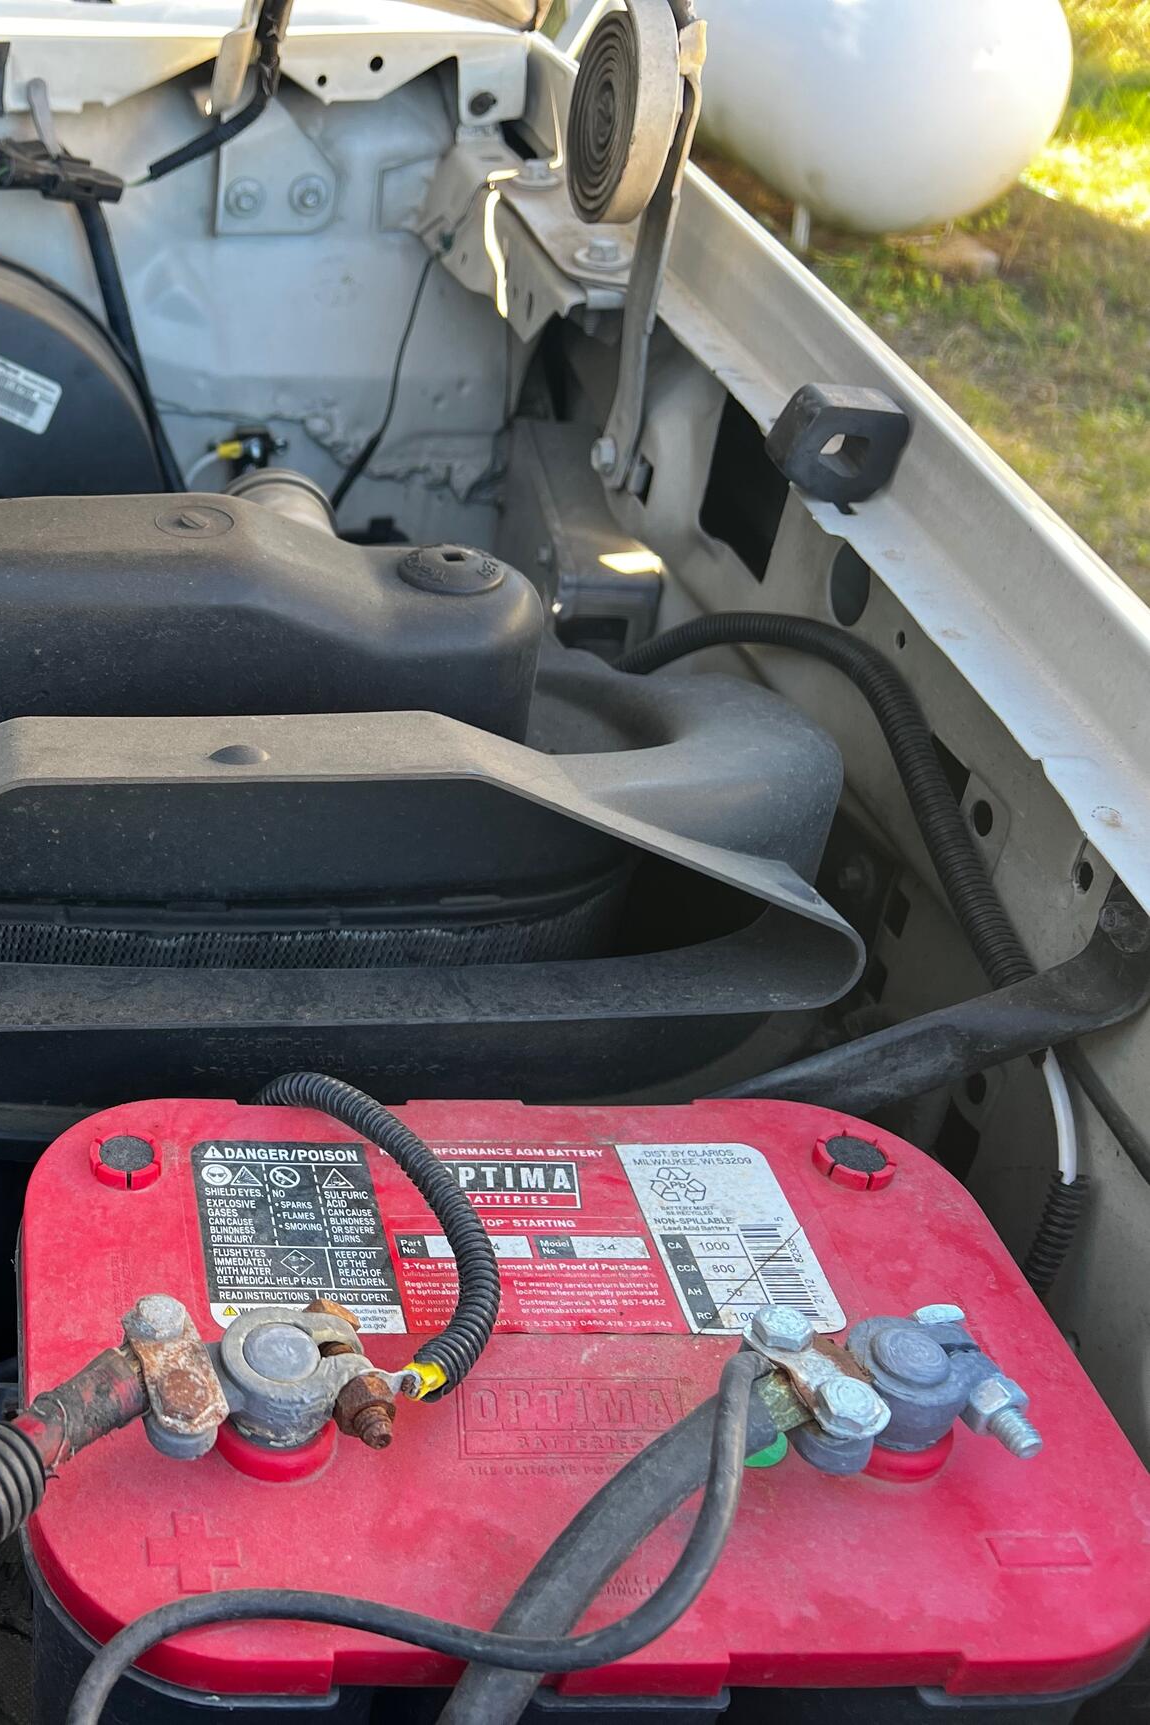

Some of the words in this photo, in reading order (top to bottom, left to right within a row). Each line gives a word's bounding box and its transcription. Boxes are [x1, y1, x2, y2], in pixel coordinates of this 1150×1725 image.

[224, 1147, 358, 1162] DANGER/POISON
[433, 1148, 513, 1156] RFORMANCE
[516, 1148, 544, 1156] AGM
[547, 1148, 603, 1158] BATTERY
[671, 1150, 685, 1158] BY
[687, 1149, 734, 1157] CLARIOS
[633, 1158, 700, 1166] MILWAUKEE,
[703, 1157, 716, 1165] WI
[717, 1157, 752, 1165] 53209
[446, 1166, 572, 1190] PTIMA
[670, 1181, 686, 1189] Pb
[204, 1187, 237, 1197] SHIELD
[238, 1188, 264, 1197] EYES.
[272, 1189, 286, 1198] NO
[324, 1191, 369, 1200] SULFURIC
[206, 1199, 257, 1209] EXPLOSIVE
[326, 1199, 348, 1208] ACID
[466, 1195, 549, 1205] ATTERIES
[280, 1201, 313, 1209] SPARKS
[207, 1208, 238, 1217] GASES
[282, 1212, 316, 1220] FLAMES
[327, 1208, 345, 1216] CAN
[345, 1209, 373, 1217] CAUSE
[209, 1217, 225, 1226] CAN
[226, 1218, 254, 1226] CAUSE
[329, 1217, 376, 1226] BLINDNESS
[512, 1219, 577, 1228] STARTING
[653, 1217, 734, 1225] NON-SPILLABLE
[210, 1226, 256, 1234] BLINDNESS
[284, 1222, 323, 1231] SMOKING
[331, 1226, 344, 1234] OR
[344, 1226, 376, 1235] SEVERE
[211, 1235, 223, 1243] OR
[224, 1235, 256, 1243] INJURY.
[400, 1239, 421, 1247] Part
[540, 1239, 570, 1247] Model
[667, 1242, 683, 1250] CA
[699, 1241, 731, 1251] 1000
[213, 1248, 243, 1257] FLUSH
[243, 1249, 266, 1257] EYES
[335, 1251, 358, 1259] KEEP
[359, 1251, 377, 1259] OUT
[542, 1247, 559, 1255] No.
[214, 1257, 272, 1267] IMMEDIATELY
[336, 1259, 349, 1268] OF
[350, 1259, 367, 1268] THE
[403, 1262, 435, 1270] 3-Year
[437, 1262, 457, 1270] FRE
[215, 1266, 239, 1275] WITH
[240, 1267, 274, 1276] WATER.
[535, 1263, 558, 1271] with
[559, 1263, 587, 1271] Proof
[588, 1263, 598, 1271] of
[600, 1263, 652, 1271] Purchase.
[712, 1264, 736, 1273] 800
[338, 1268, 369, 1277] REACH
[369, 1268, 382, 1277] OF
[216, 1276, 234, 1284] GET
[235, 1276, 276, 1285] MEDICAL
[276, 1276, 300, 1285] HELP
[301, 1277, 326, 1286] FAST.
[340, 1277, 388, 1286] CHILDREN.
[404, 1281, 440, 1290] Register
[528, 1282, 563, 1290] warranty
[619, 1282, 649, 1290] battery
[219, 1291, 243, 1300] READ
[244, 1291, 313, 1301] INSTRUCTIONS.
[550, 1288, 576, 1296] where
[576, 1289, 614, 1298] originally
[615, 1289, 659, 1297] purchased
[687, 1288, 703, 1296] AH
[324, 1292, 338, 1301] DO
[339, 1292, 360, 1302] NOT
[361, 1293, 391, 1302] OPEN.
[518, 1298, 559, 1306] Customer
[697, 1312, 713, 1320] RC
[471, 1388, 675, 1424] OPTIMA
[517, 1435, 644, 1450] BATTERIES
